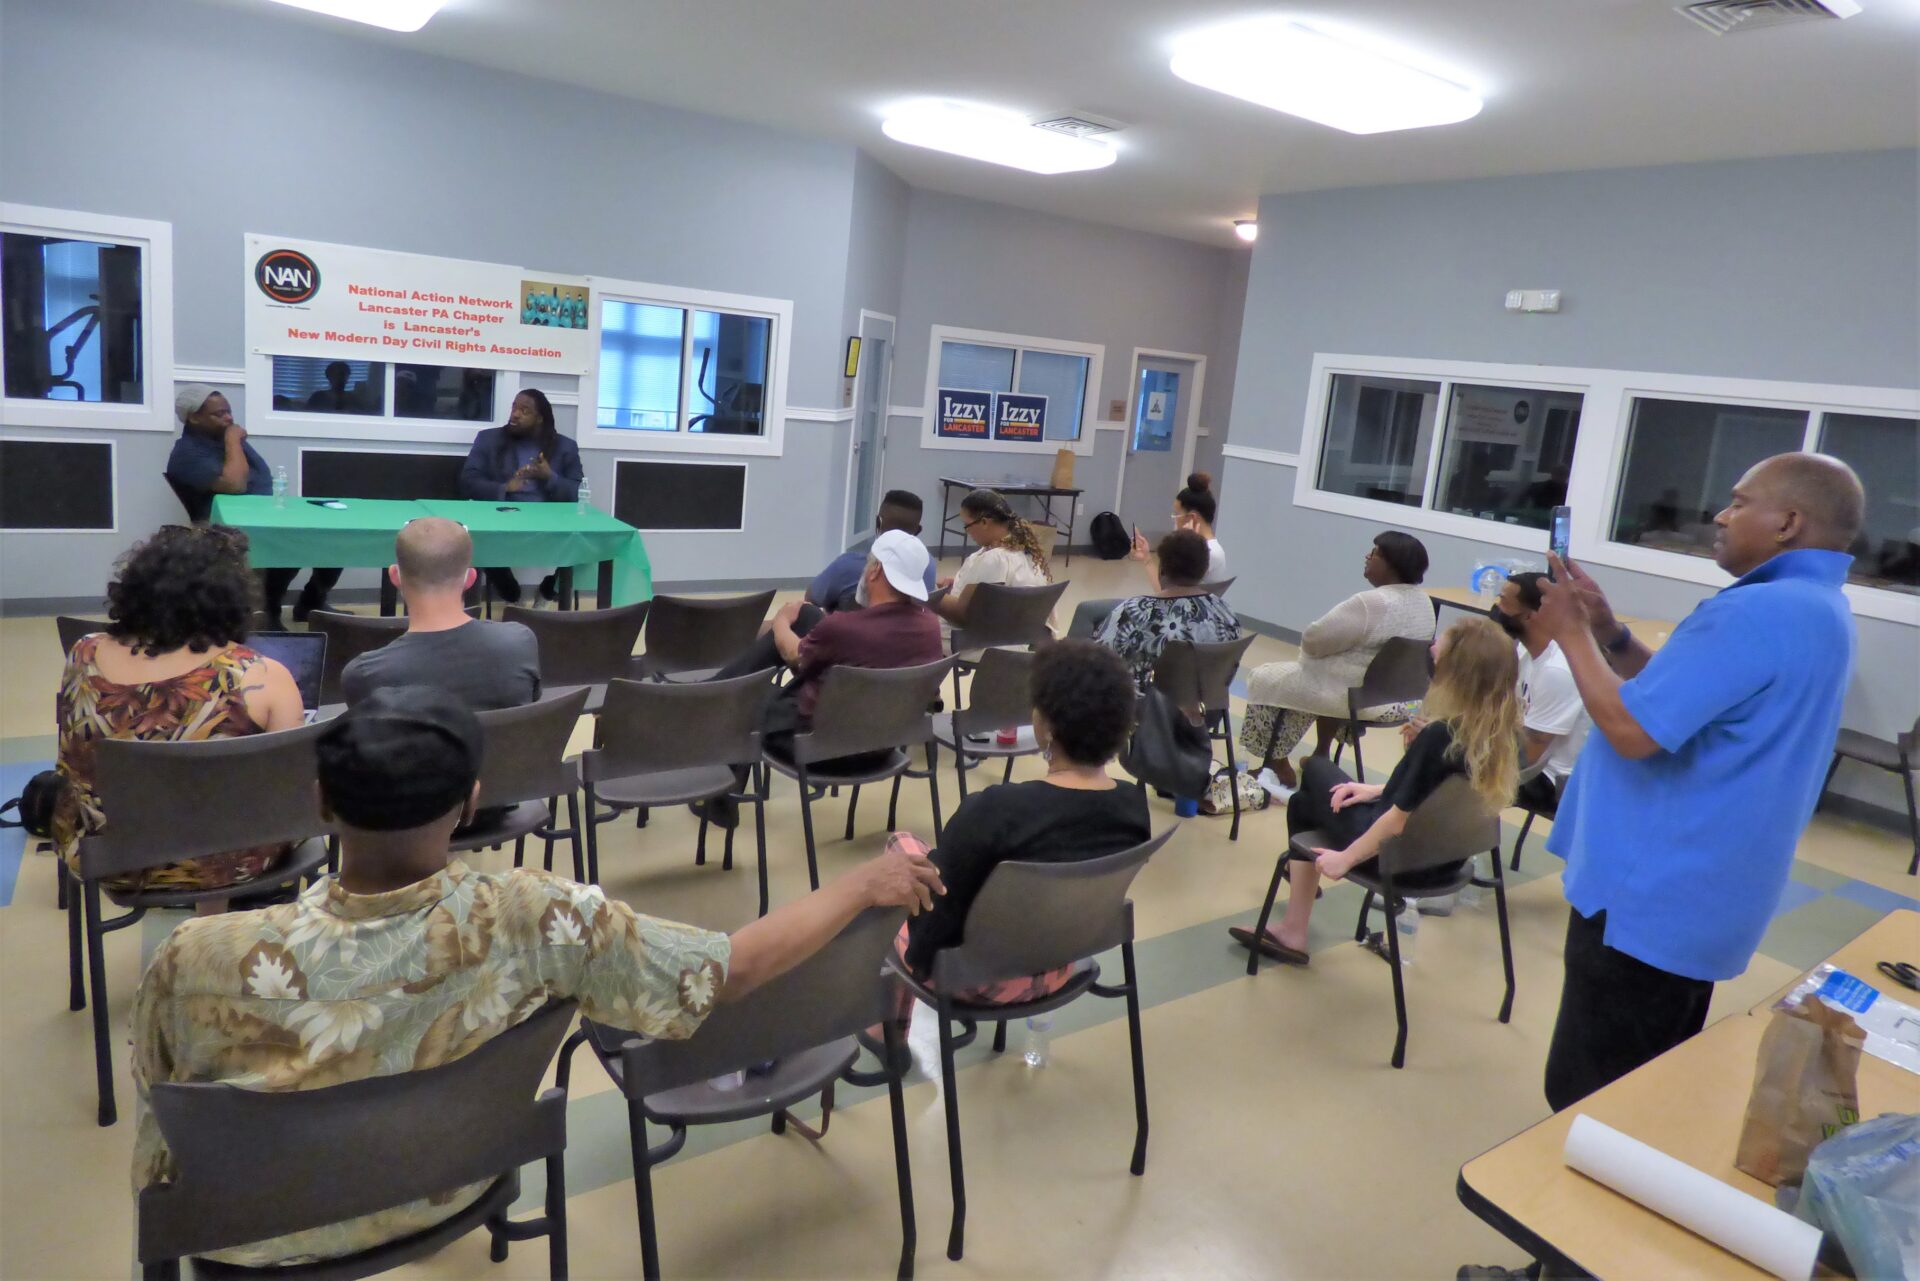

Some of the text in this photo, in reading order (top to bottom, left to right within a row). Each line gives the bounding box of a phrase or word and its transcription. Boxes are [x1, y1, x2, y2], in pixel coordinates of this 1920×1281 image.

[265, 265, 311, 289] NAN
[348, 284, 513, 309] National Action Network
[358, 301, 504, 324] Lancaster PA Chapter
[383, 320, 481, 337] is Lancaster's
[287, 328, 562, 358] New Modern Day Civil Rights Association
[943, 397, 986, 423] Izzy
[1000, 401, 1041, 428] Izzy
[943, 423, 985, 433] LANCASTER
[999, 426, 1039, 436] LANCASTER
